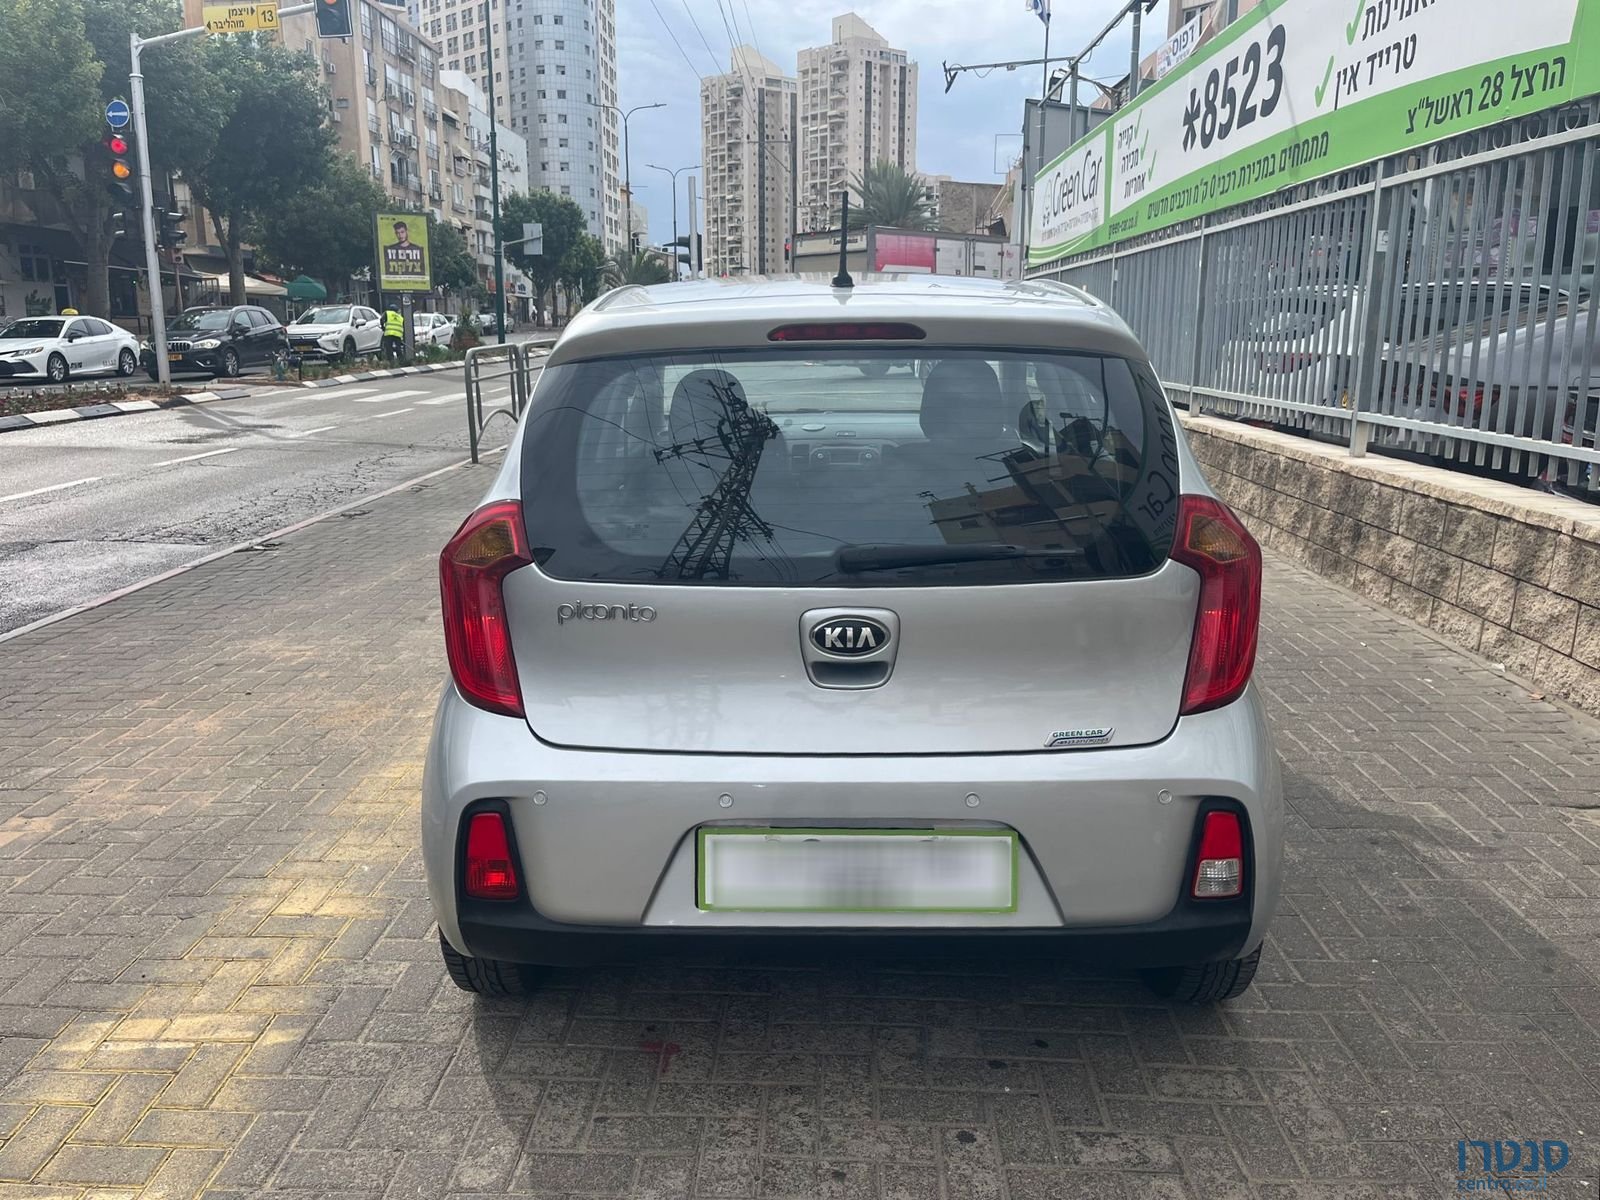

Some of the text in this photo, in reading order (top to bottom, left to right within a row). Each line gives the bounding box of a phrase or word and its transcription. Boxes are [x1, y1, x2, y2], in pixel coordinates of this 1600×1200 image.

[228, 7, 249, 19] ויצמן
[261, 10, 274, 22] 13
[1172, 25, 1195, 57] דפוס
[1334, 33, 1417, 111] טרייד אין
[1510, 56, 1566, 101] הרצל
[1478, 71, 1504, 112] 28
[1121, 148, 1139, 174] מכירה
[1278, 130, 1329, 173] מתמחים
[1053, 149, 1103, 217] Green Car
[1217, 170, 1237, 196] רכבי
[1237, 153, 1276, 189] במכירת
[1123, 171, 1147, 199] אחריות
[1209, 174, 1217, 199] 0
[1147, 196, 1169, 220] חדשים
[1169, 187, 1193, 212] ורכבים
[389, 259, 421, 274] צלקת
[557, 600, 657, 625] picanto
[824, 626, 876, 649] KIA
[1052, 730, 1083, 738] GREEN
